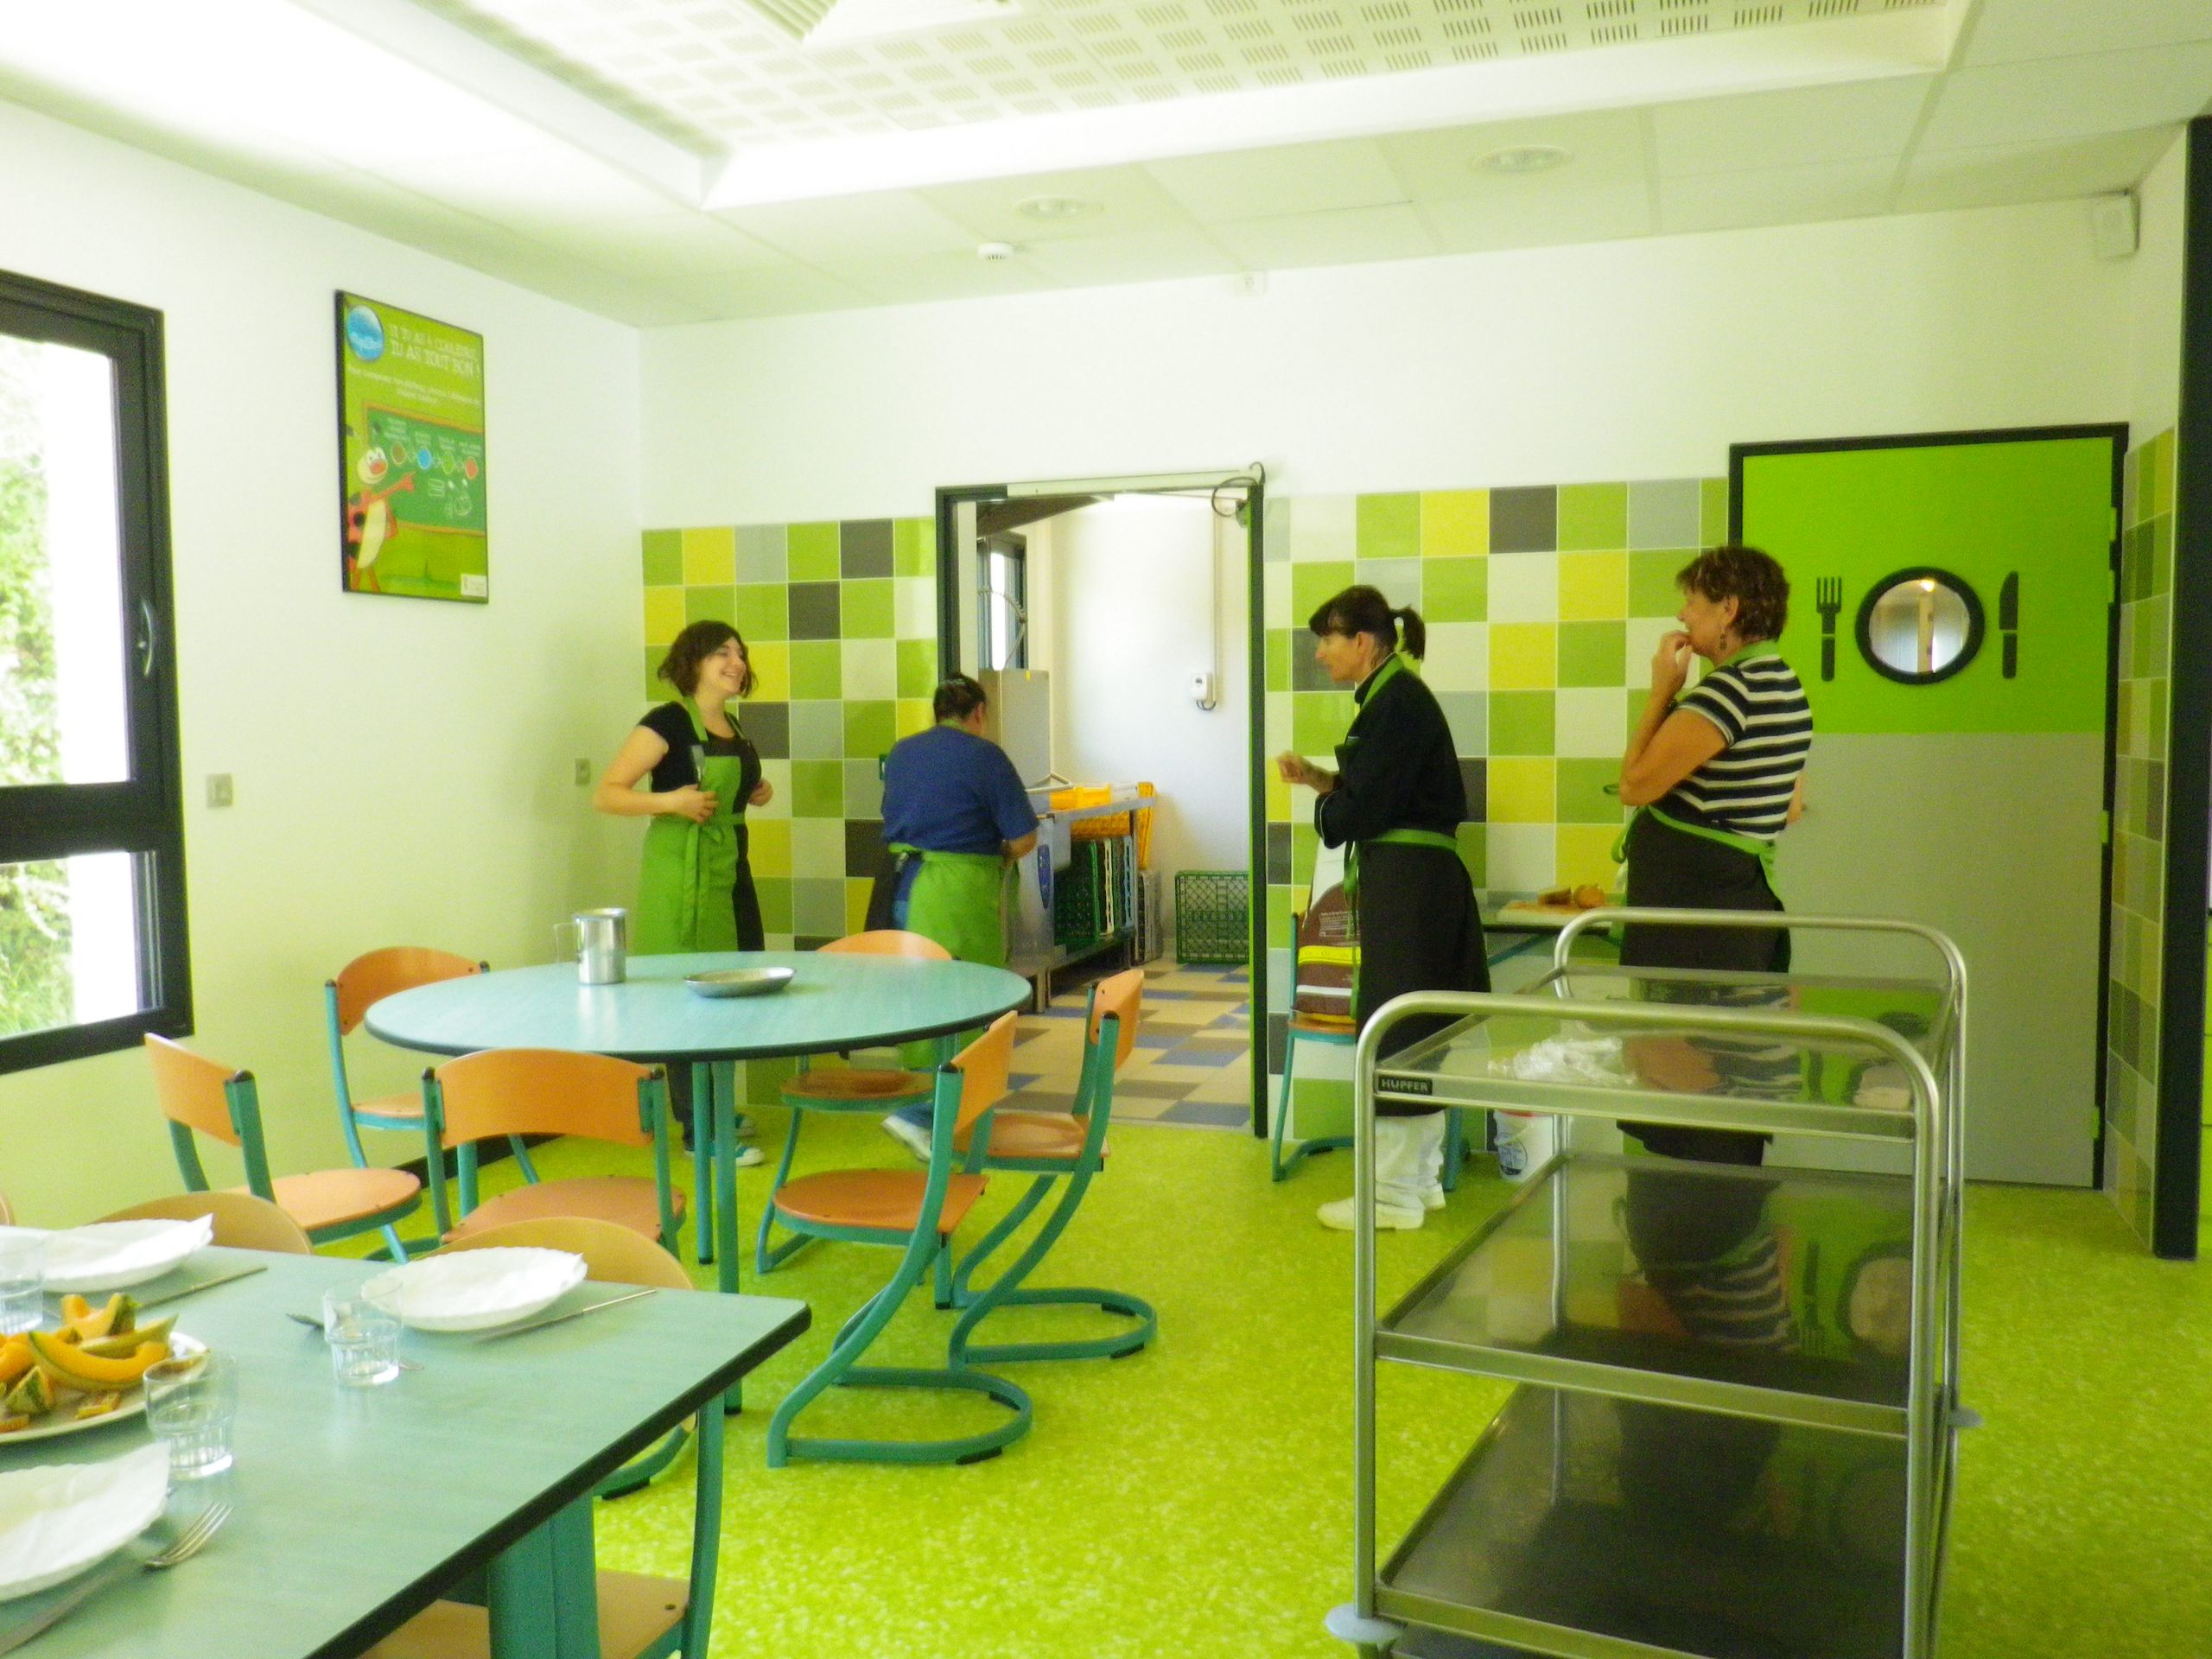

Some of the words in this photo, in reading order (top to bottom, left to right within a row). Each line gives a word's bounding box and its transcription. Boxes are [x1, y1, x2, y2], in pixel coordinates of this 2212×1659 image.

[391, 340, 404, 357] TU
[406, 345, 421, 361] AS
[425, 350, 451, 371] TOUT
[1381, 1078, 1428, 1091] HUPFER
